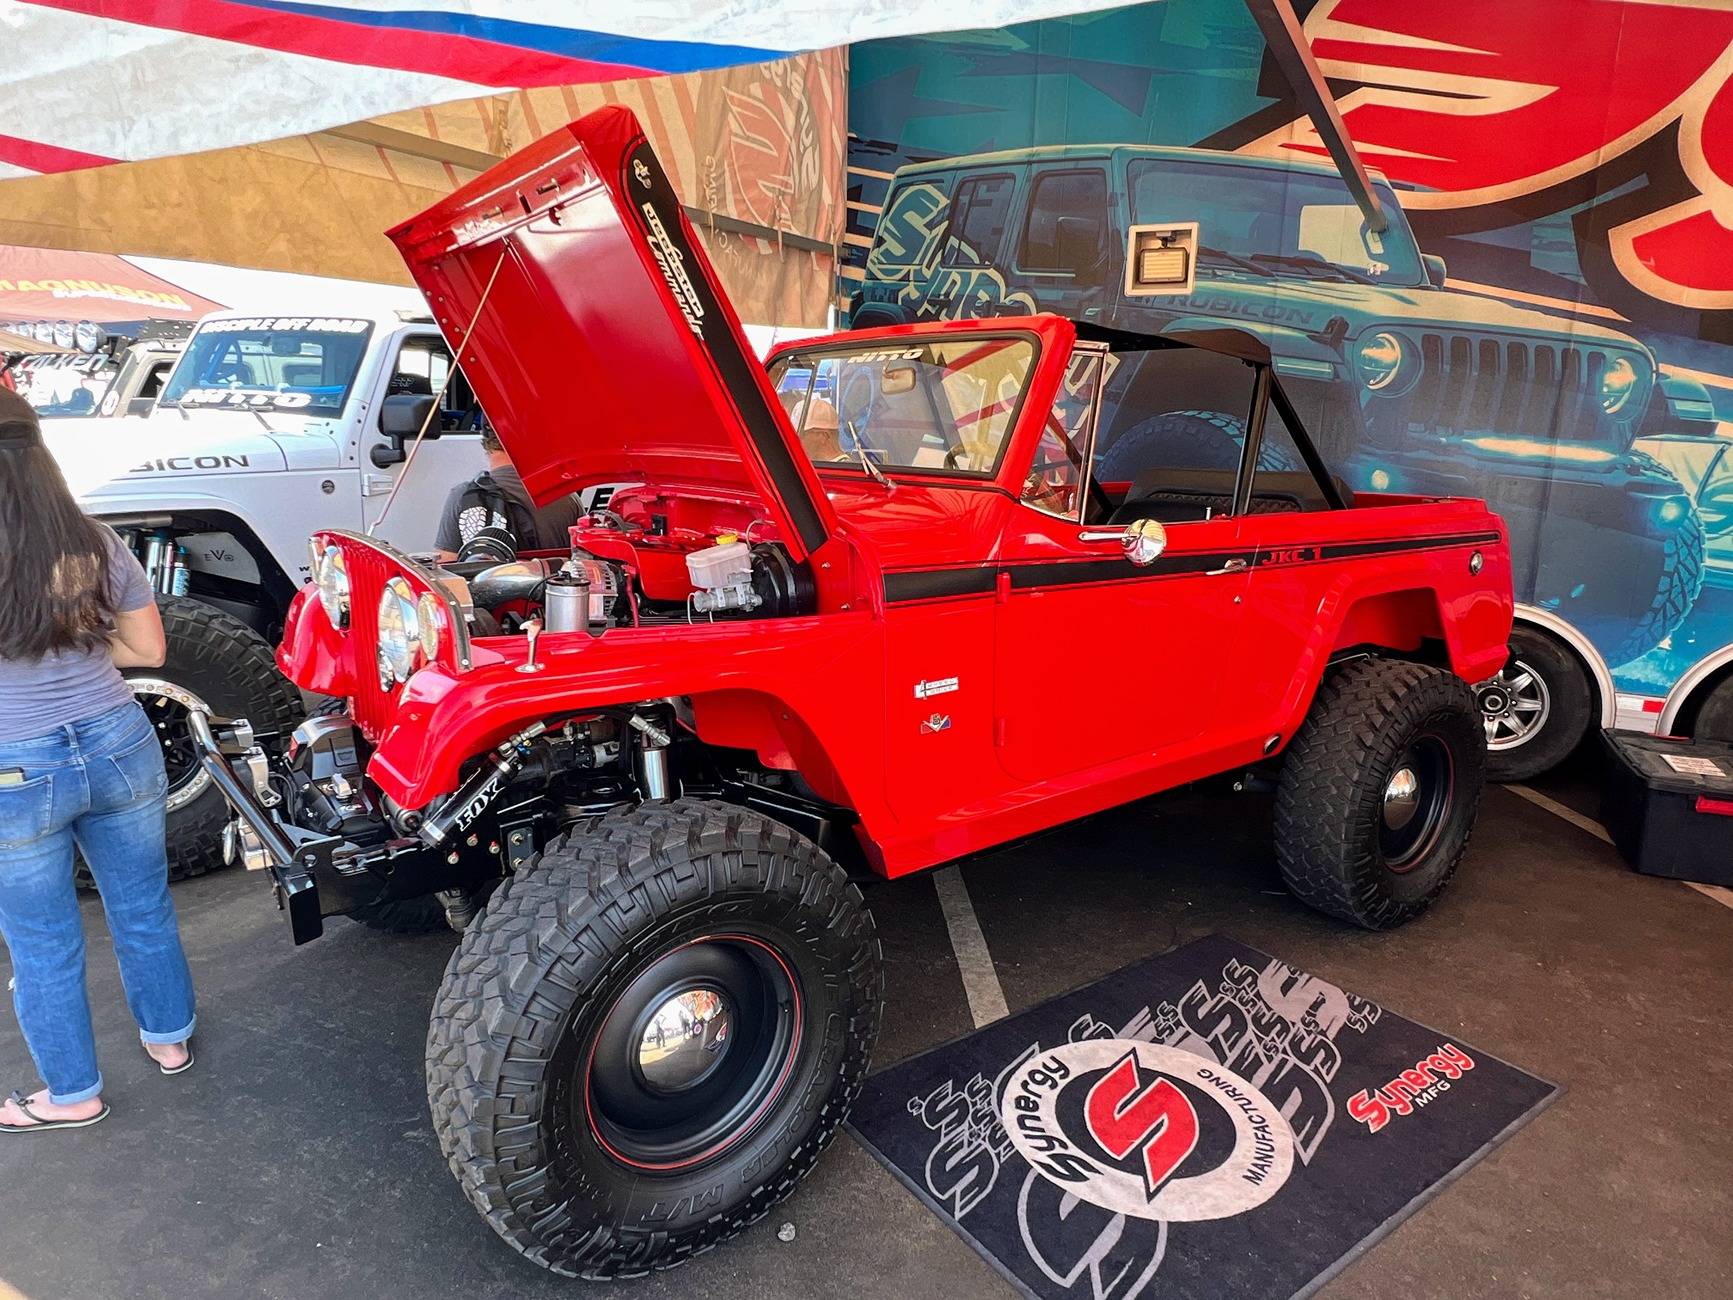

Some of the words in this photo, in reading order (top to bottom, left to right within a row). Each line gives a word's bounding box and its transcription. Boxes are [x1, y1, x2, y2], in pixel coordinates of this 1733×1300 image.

[848, 348, 924, 364] NITTO
[455, 777, 500, 832] FOX
[1014, 1055, 1105, 1182] Synergy
[1347, 1043, 1475, 1134] Synergy
[1415, 1080, 1451, 1108] MFG
[1196, 1067, 1276, 1186] MANUFACTURING
